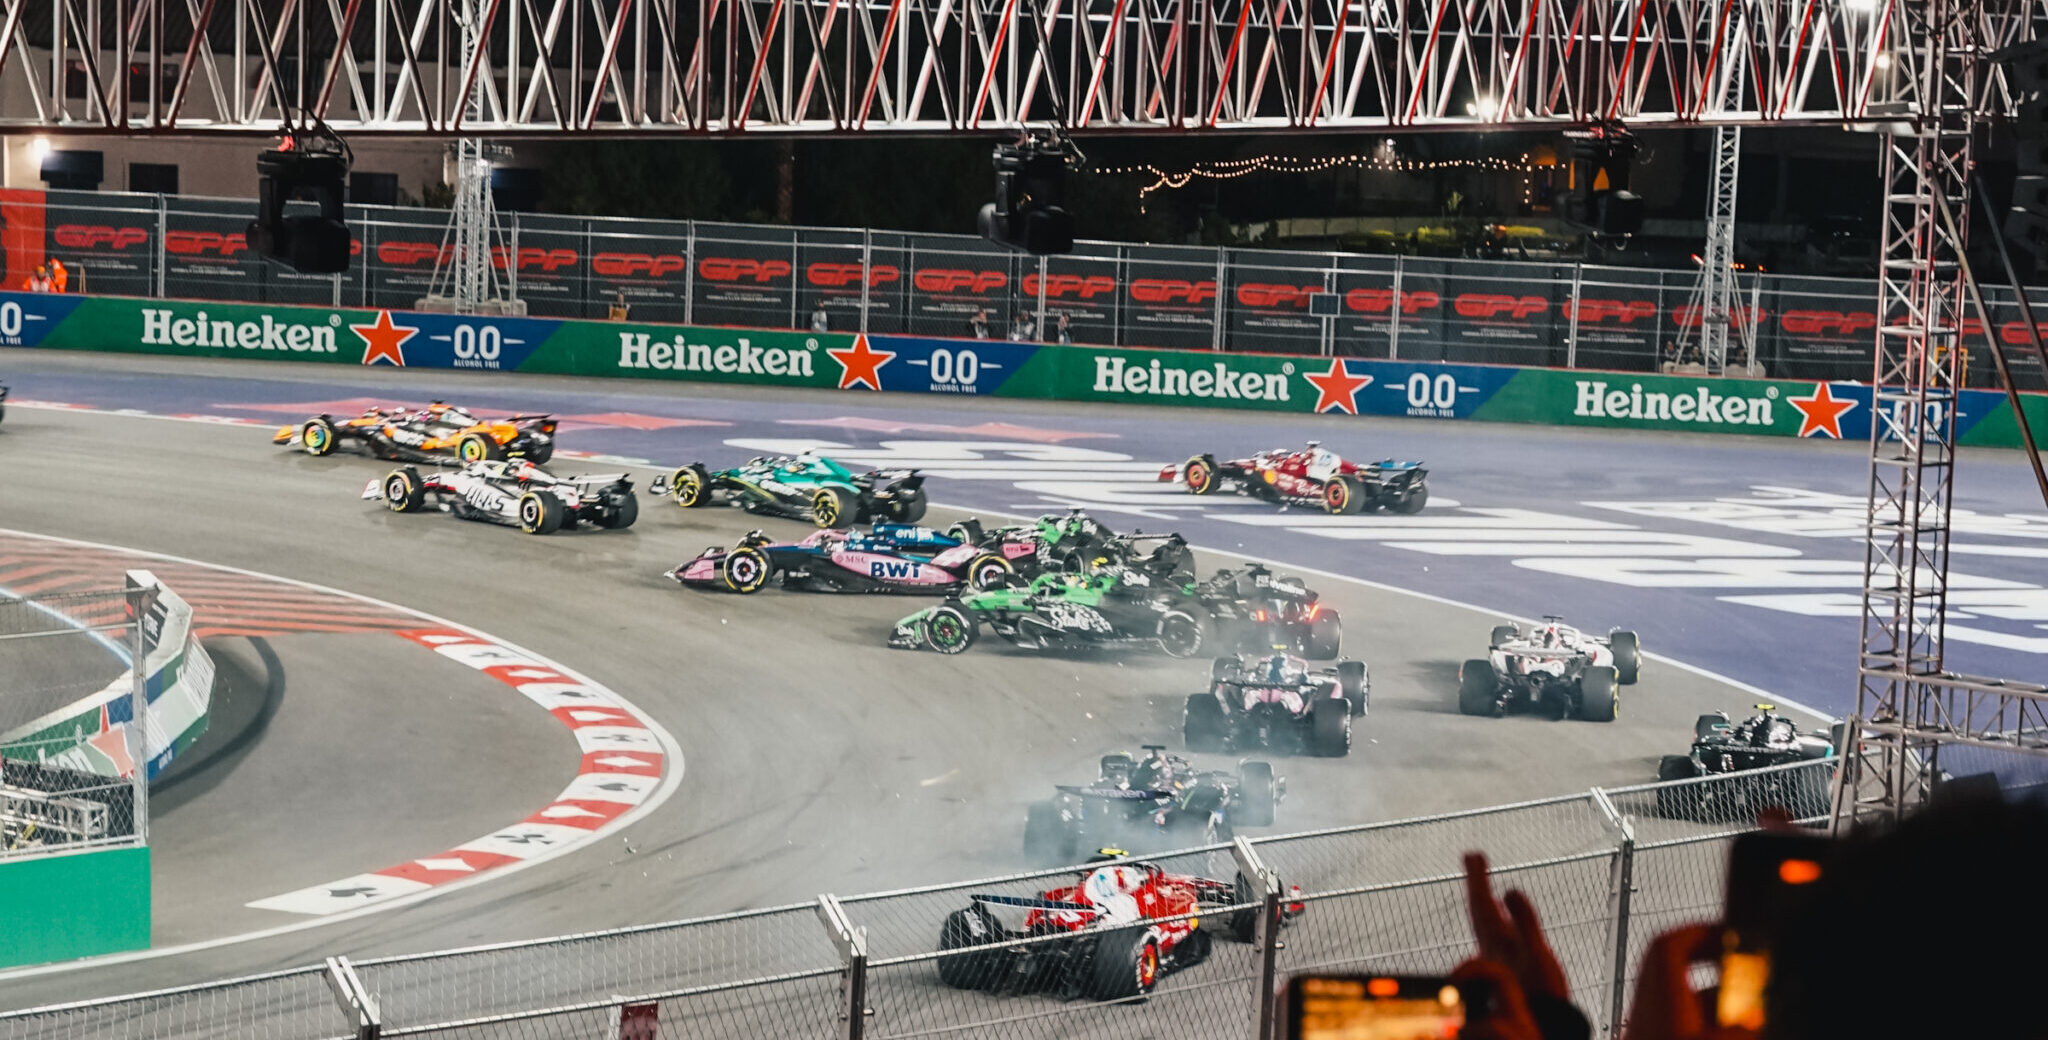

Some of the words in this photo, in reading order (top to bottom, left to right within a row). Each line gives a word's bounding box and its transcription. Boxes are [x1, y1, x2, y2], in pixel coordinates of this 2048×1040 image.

[54, 224, 148, 249] GPP
[592, 252, 685, 277] GPP
[699, 257, 791, 282] GPP
[914, 268, 1007, 293] GPP
[1454, 293, 1548, 318] GPP
[1781, 310, 1876, 334] GPP
[454, 324, 500, 360] 0.0
[454, 359, 482, 368] ALCOHOL
[485, 361, 499, 369] FREE
[930, 348, 978, 385] 0.0
[930, 383, 959, 392] ALCOHOL
[962, 385, 976, 393] FREE
[1407, 372, 1456, 409] 0.0
[1407, 407, 1437, 416] ALCOHOL
[1439, 409, 1454, 417] FREE
[895, 526, 916, 539] eni
[845, 555, 867, 564] MSC
[870, 560, 922, 578] BWT
